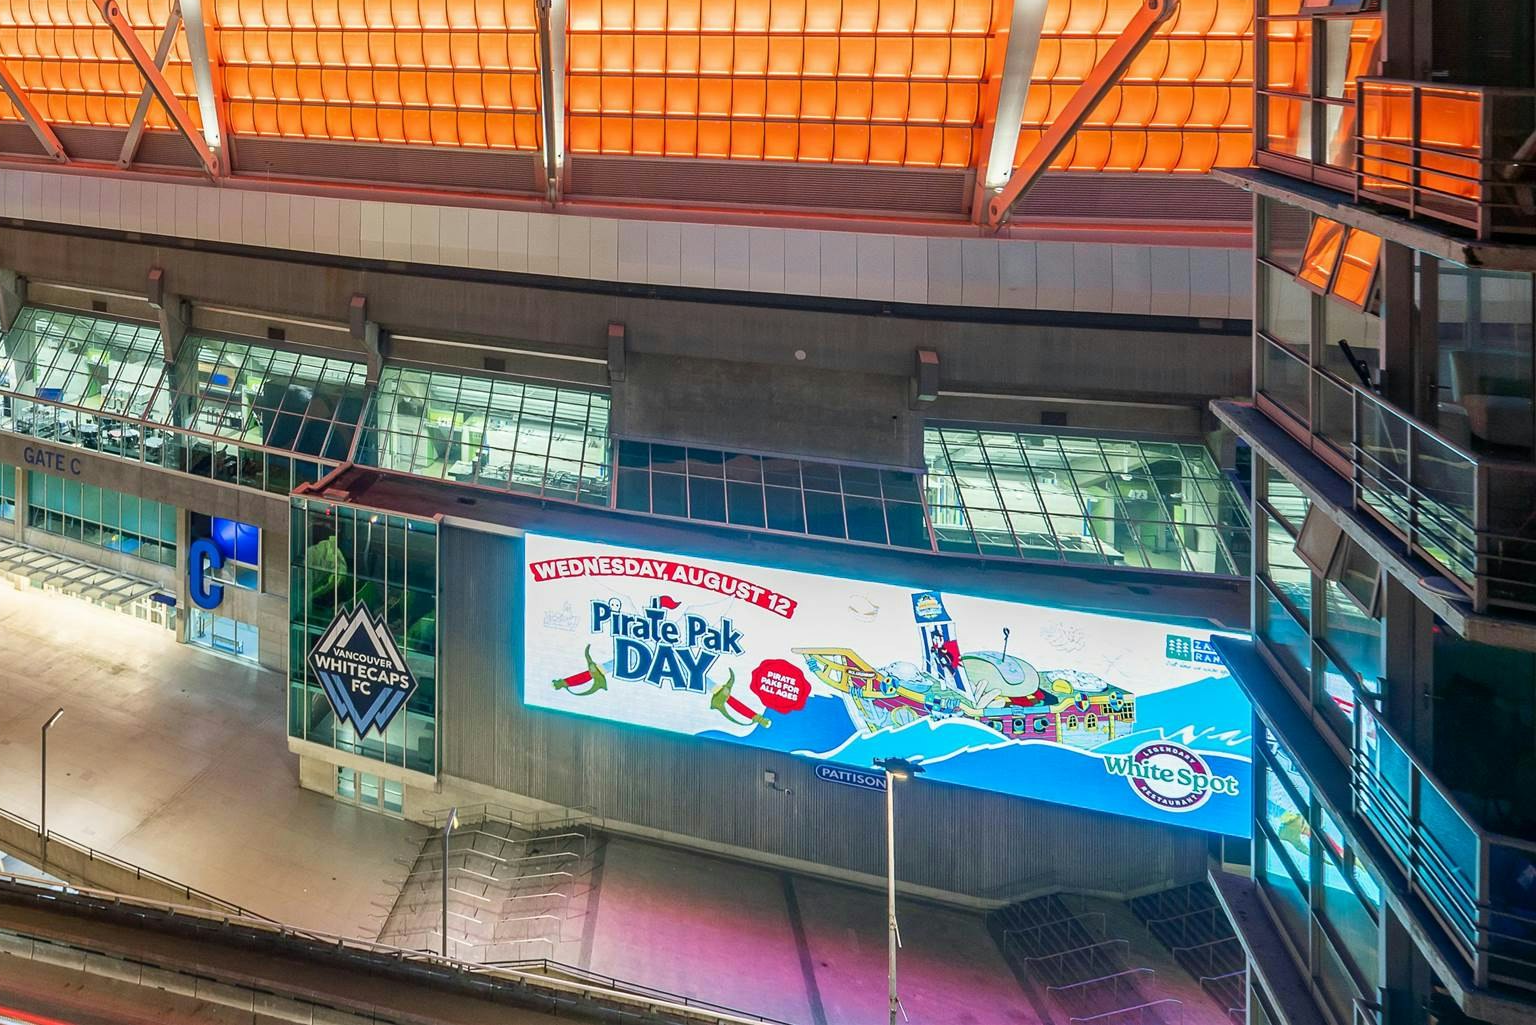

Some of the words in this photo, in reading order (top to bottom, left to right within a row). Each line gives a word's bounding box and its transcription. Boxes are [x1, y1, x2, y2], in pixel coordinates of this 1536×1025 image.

[24, 446, 65, 472] GATE
[70, 457, 81, 475] C
[1128, 489, 1148, 500] 423
[189, 538, 224, 610] C
[534, 556, 668, 582] WEDNESDAY,
[671, 566, 768, 604] AUGUST
[767, 593, 793, 616] 12
[591, 596, 680, 644] Pirate
[685, 616, 744, 656] Pak
[1194, 640, 1211, 652] ZA
[333, 647, 393, 669] VANCOUVER
[615, 636, 720, 694] DAY
[1195, 652, 1220, 663] RAN
[314, 654, 409, 689] WHITECAPS
[767, 671, 796, 685] PIRATE
[351, 678, 371, 695] FC
[760, 683, 775, 694] ALL
[775, 689, 798, 701] AGES
[761, 676, 783, 689] PAKS
[782, 683, 800, 695] FOR
[1142, 745, 1196, 763] LEGENDARY
[822, 767, 886, 789] PATTISON
[1103, 755, 1175, 783] White
[1177, 768, 1238, 794] Spot
[1140, 785, 1198, 807] RESTAURANT
